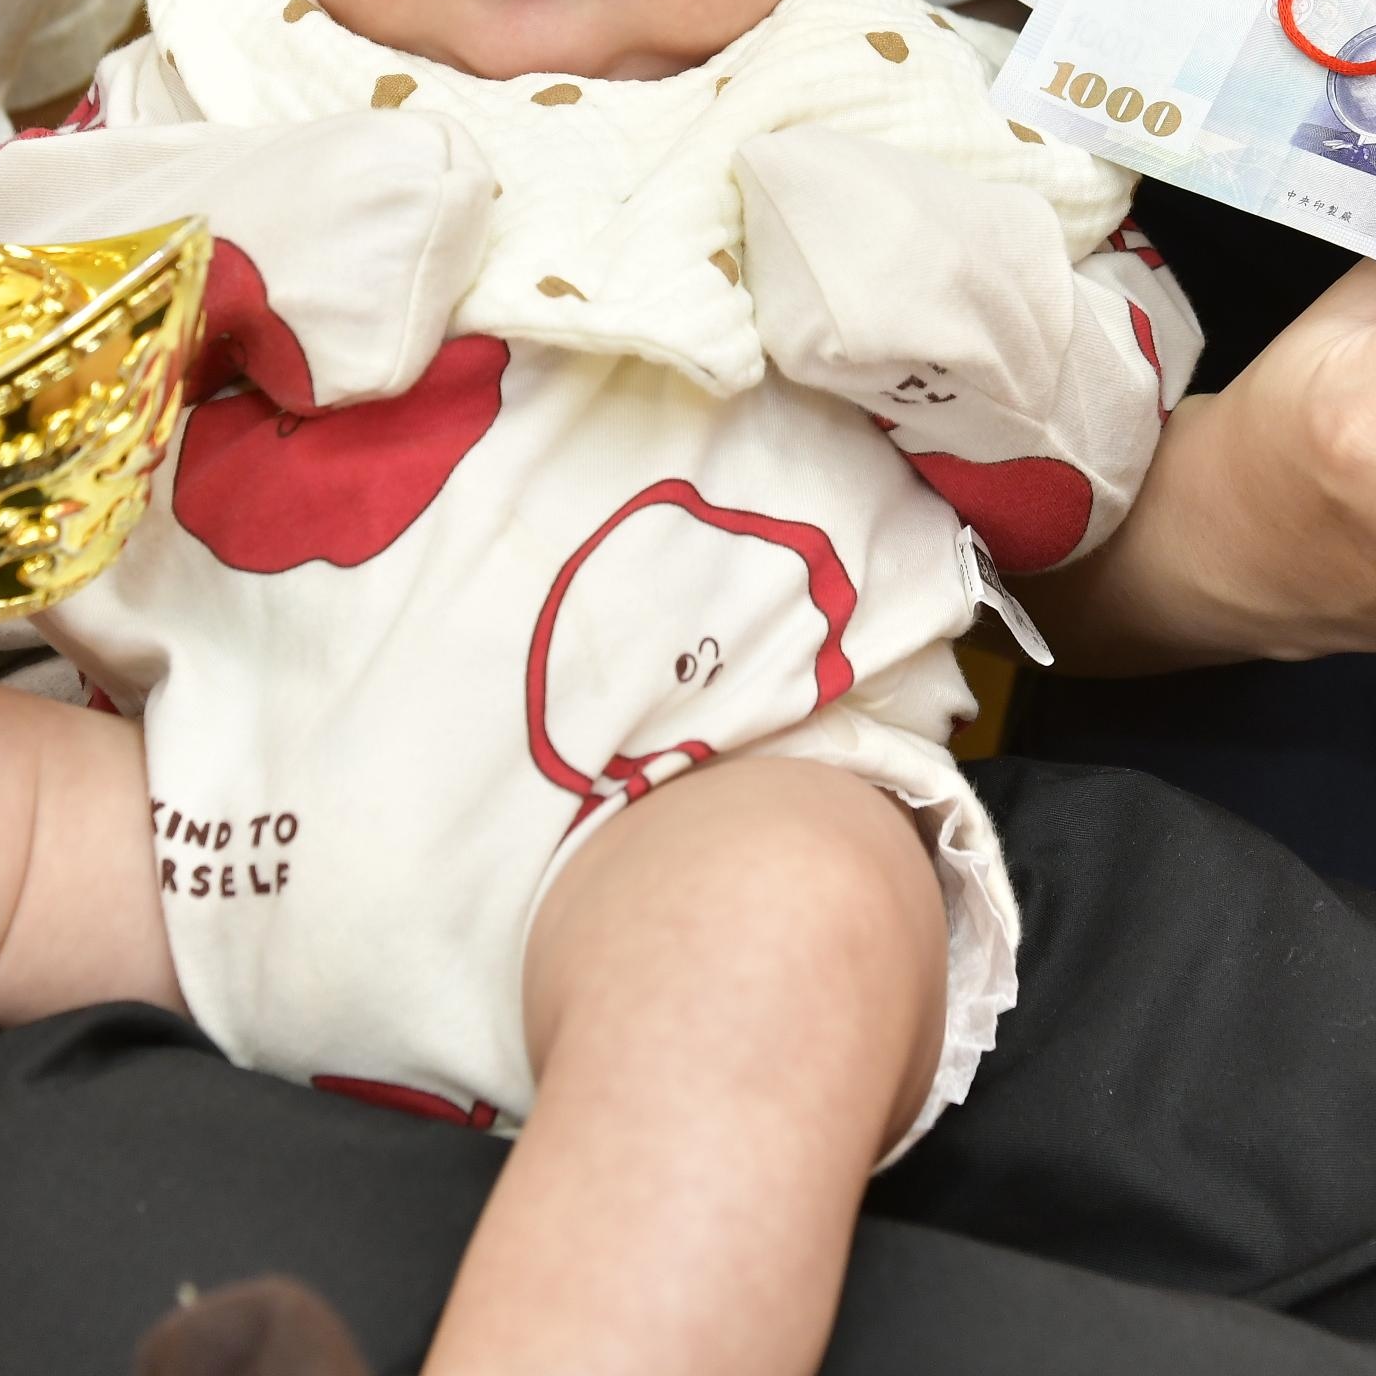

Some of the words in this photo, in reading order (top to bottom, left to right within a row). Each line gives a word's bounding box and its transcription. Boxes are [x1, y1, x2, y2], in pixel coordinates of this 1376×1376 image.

[1040, 60, 1182, 137] 1000
[1286, 189, 1353, 223] 中央印製廠
[250, 812, 298, 847] TO
